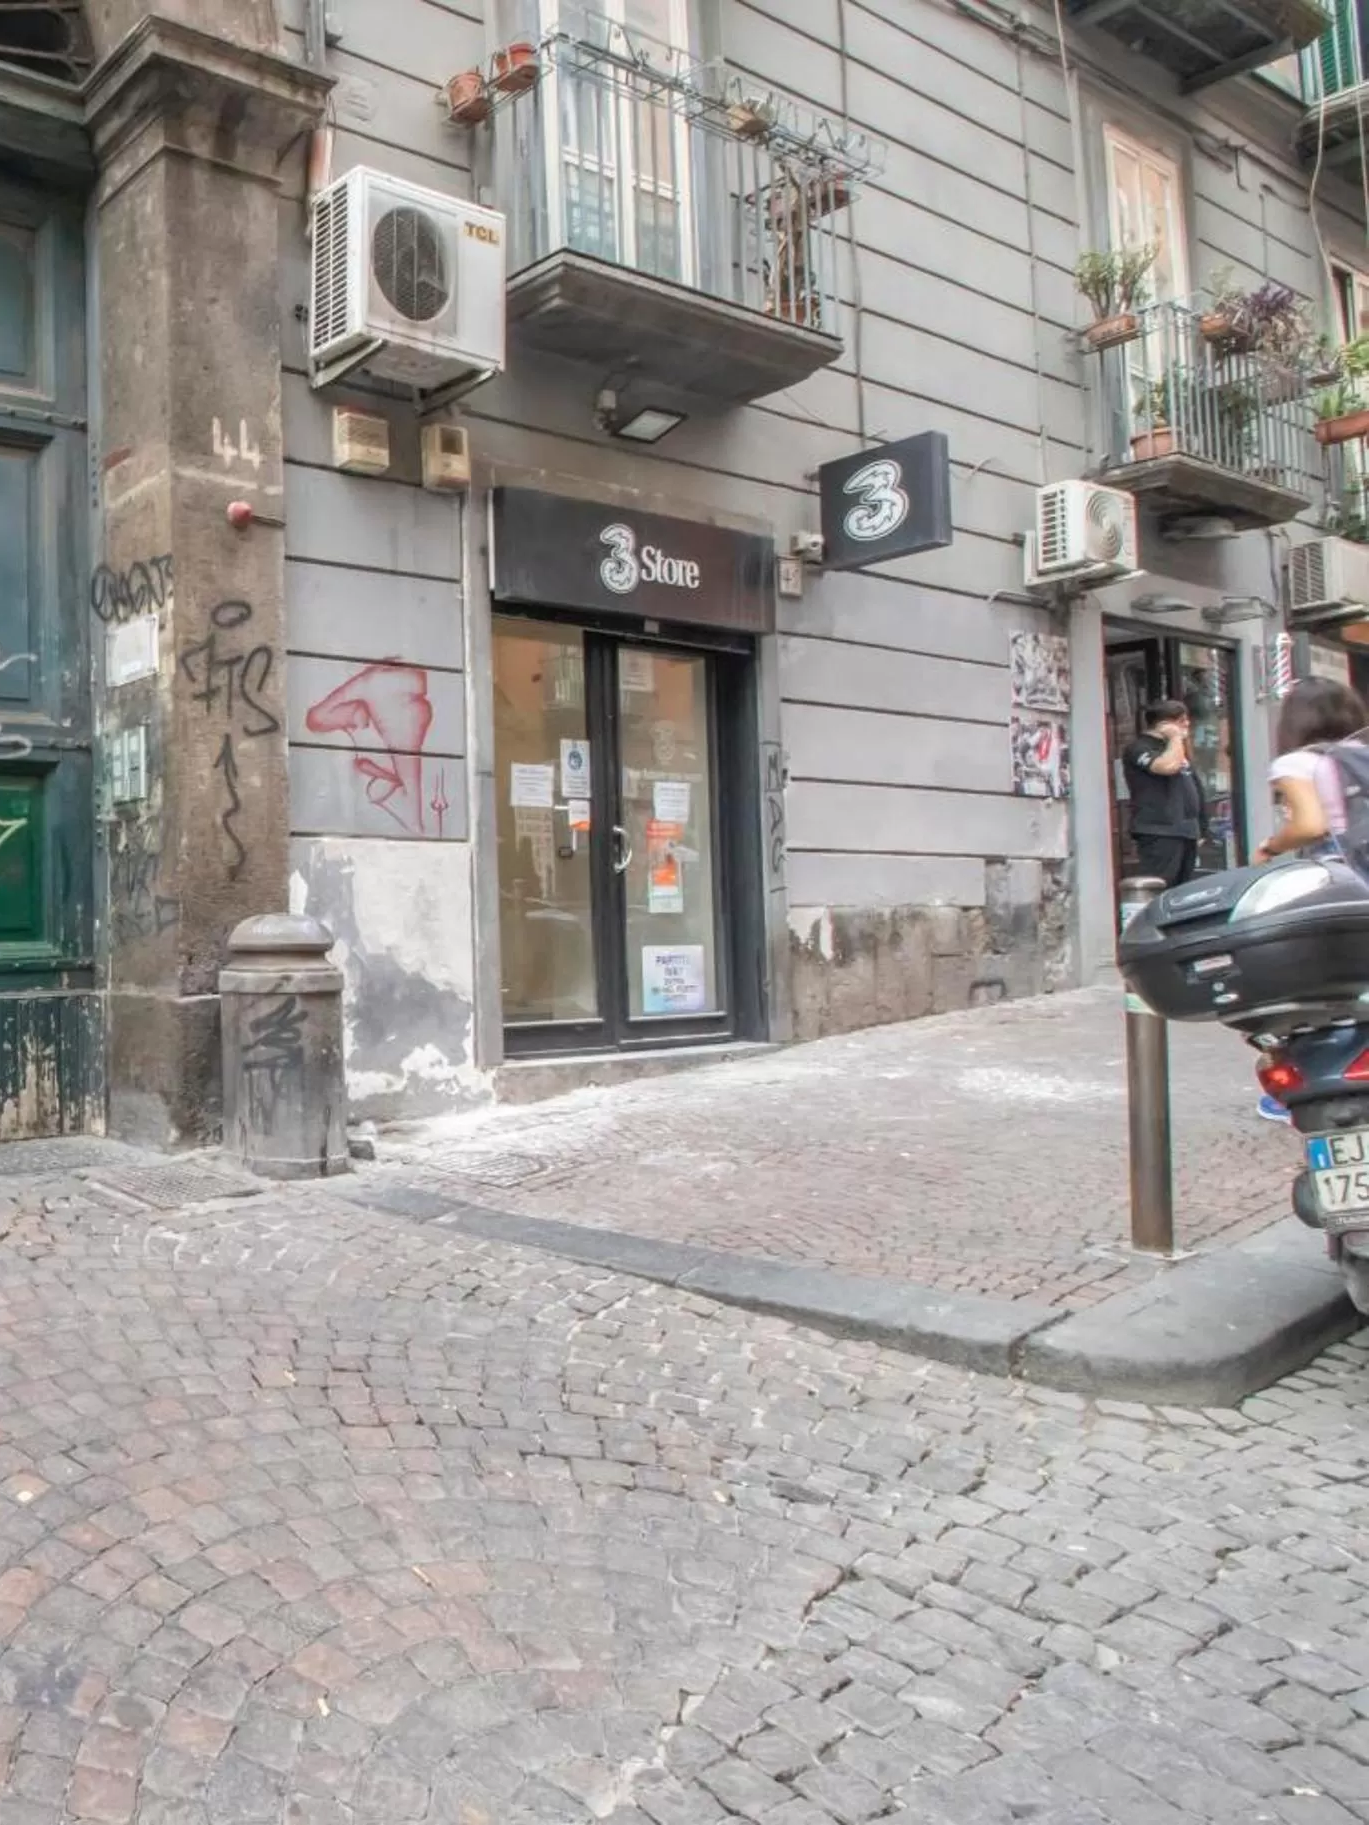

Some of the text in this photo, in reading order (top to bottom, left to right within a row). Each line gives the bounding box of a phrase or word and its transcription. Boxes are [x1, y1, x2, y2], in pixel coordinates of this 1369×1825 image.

[464, 221, 500, 246] TCL
[842, 459, 910, 541] 3
[600, 523, 701, 595] 3 Store
[1330, 1134, 1366, 1165] EJ
